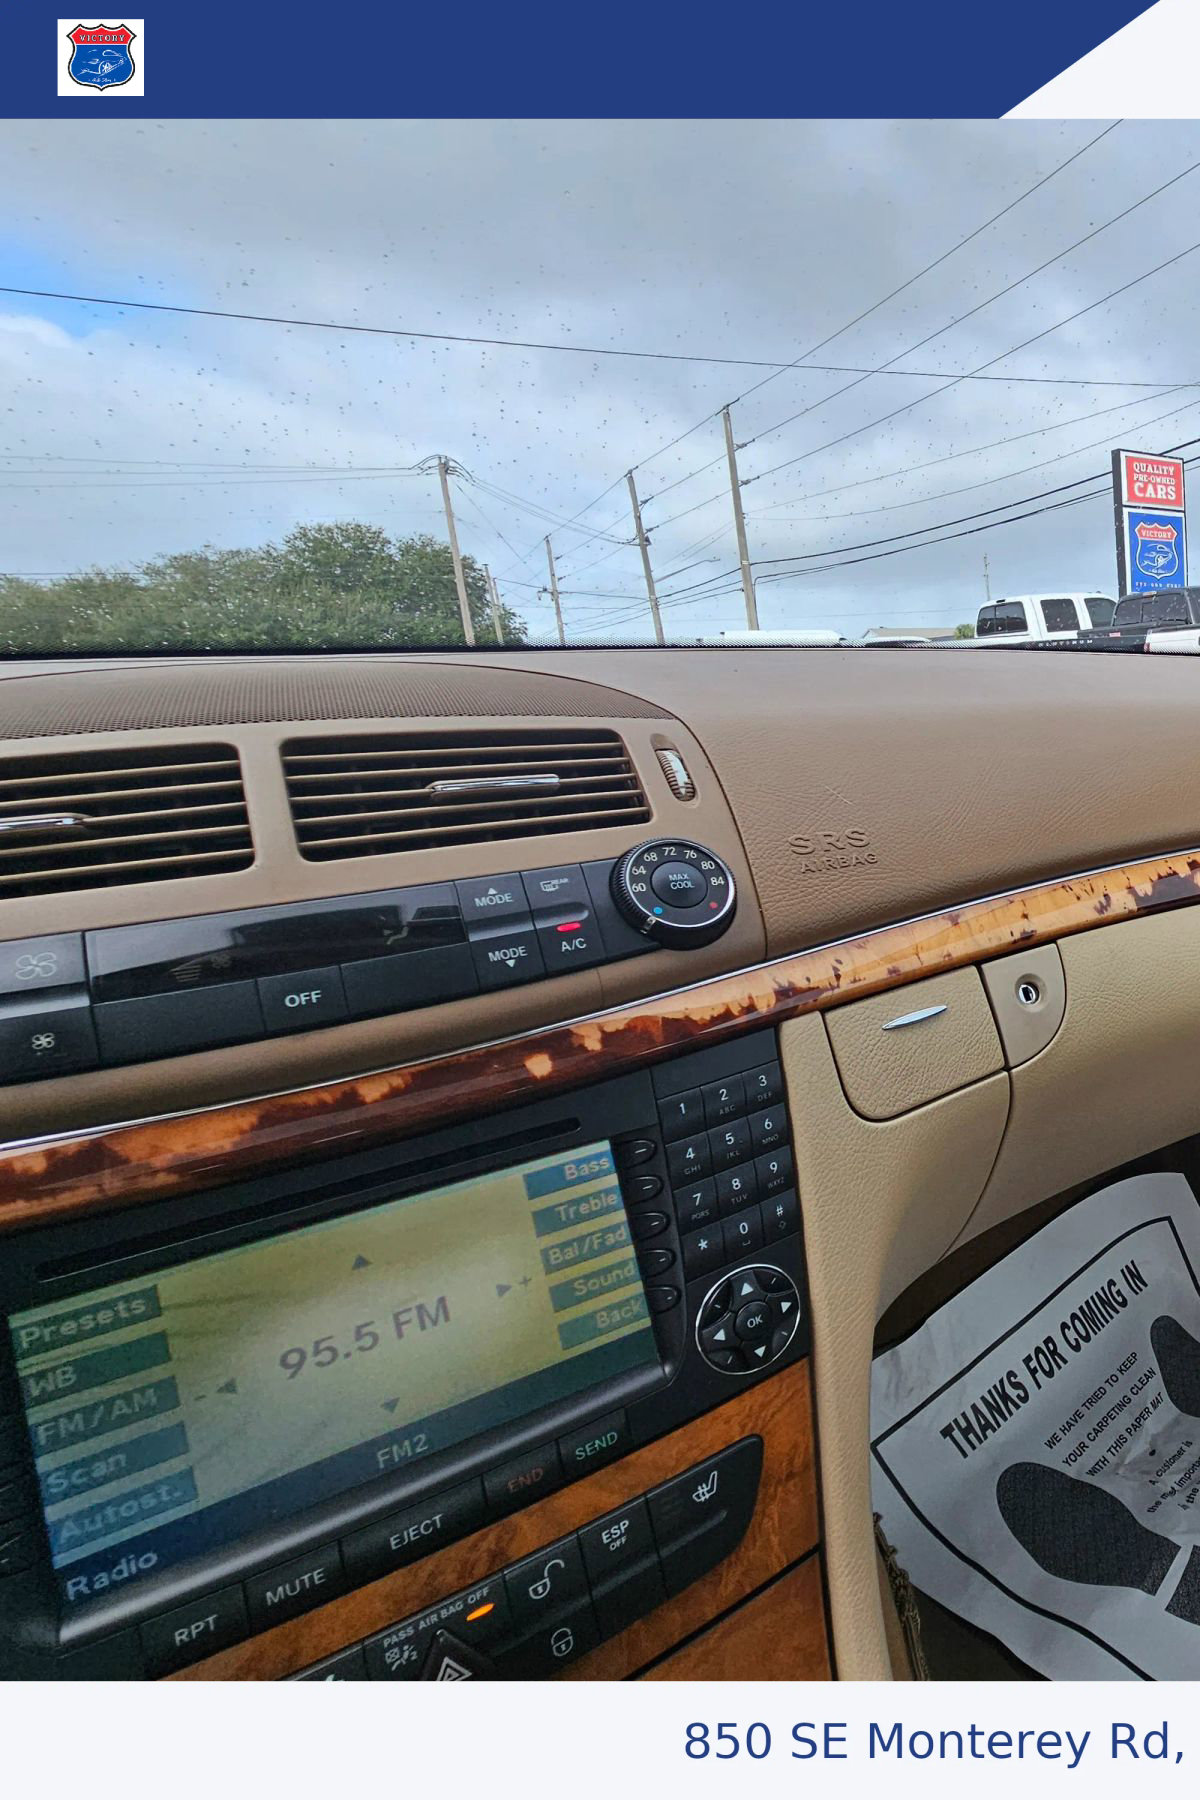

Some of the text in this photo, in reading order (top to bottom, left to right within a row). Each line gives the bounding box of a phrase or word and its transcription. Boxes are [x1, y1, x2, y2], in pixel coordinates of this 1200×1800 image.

[1133, 462, 1175, 476] QUALITY
[1133, 473, 1176, 485] PRE-OWNED
[1134, 482, 1176, 500] CARS
[1140, 529, 1172, 538] VICTORY
[788, 829, 870, 855] SRS
[643, 852, 658, 862] 68
[662, 846, 677, 856] 72
[684, 849, 697, 859] 76
[631, 865, 647, 875] 64
[701, 860, 715, 870] 80
[800, 853, 879, 874] AIRBAG
[668, 873, 690, 881] MAX
[670, 881, 695, 890] COOL
[710, 876, 725, 886] 84
[631, 882, 646, 892] 60
[474, 892, 513, 908] MODE
[560, 938, 587, 952] A/C
[488, 946, 528, 963] MODE
[284, 990, 322, 1008] OFF
[758, 1075, 768, 1087] 3
[719, 1088, 729, 1101] 2
[679, 1102, 686, 1114] 1
[718, 1104, 736, 1115] ABC
[764, 1118, 773, 1130] 6
[725, 1132, 735, 1145] 5
[686, 1147, 695, 1160] 4
[563, 1155, 611, 1182] Bass
[769, 1161, 778, 1174] 9
[731, 1178, 741, 1191] 8
[555, 1192, 618, 1222] Treble
[692, 1193, 702, 1206] 7
[739, 1222, 748, 1235] 0
[548, 1225, 627, 1265] Bal/Fad
[573, 1260, 636, 1297] Sound
[596, 1297, 644, 1330] Back
[746, 1314, 763, 1328] OK
[19, 1297, 147, 1349] Presets
[279, 1295, 451, 1380] 95.5 FM
[939, 1259, 1149, 1460] THANKS FOR COMING IN
[28, 1364, 77, 1397] WB
[1044, 1351, 1138, 1450] WE HAVE TRIED TO KEEP
[36, 1386, 159, 1447] FM/AM
[1062, 1367, 1157, 1468] YOUR CARPETING CLEAN
[1085, 1391, 1164, 1477] WITH THIS PAPER MAT
[376, 1433, 430, 1469] FM2
[574, 1431, 619, 1461] SEND
[1156, 1446, 1186, 1478] customer
[1181, 1440, 1193, 1448] is
[47, 1451, 128, 1495] Scan
[507, 1467, 544, 1493] END
[1186, 1487, 1200, 1504] the
[58, 1484, 183, 1545] Autost.
[1147, 1500, 1162, 1513] the
[389, 1514, 444, 1551] EJECT
[601, 1519, 630, 1545] ESP
[609, 1535, 628, 1551] OFF
[66, 1549, 159, 1602] Radio
[266, 1568, 328, 1607] MUTE
[383, 1586, 490, 1648] PASS AIR BAG OFF
[174, 1614, 219, 1647] RPT
